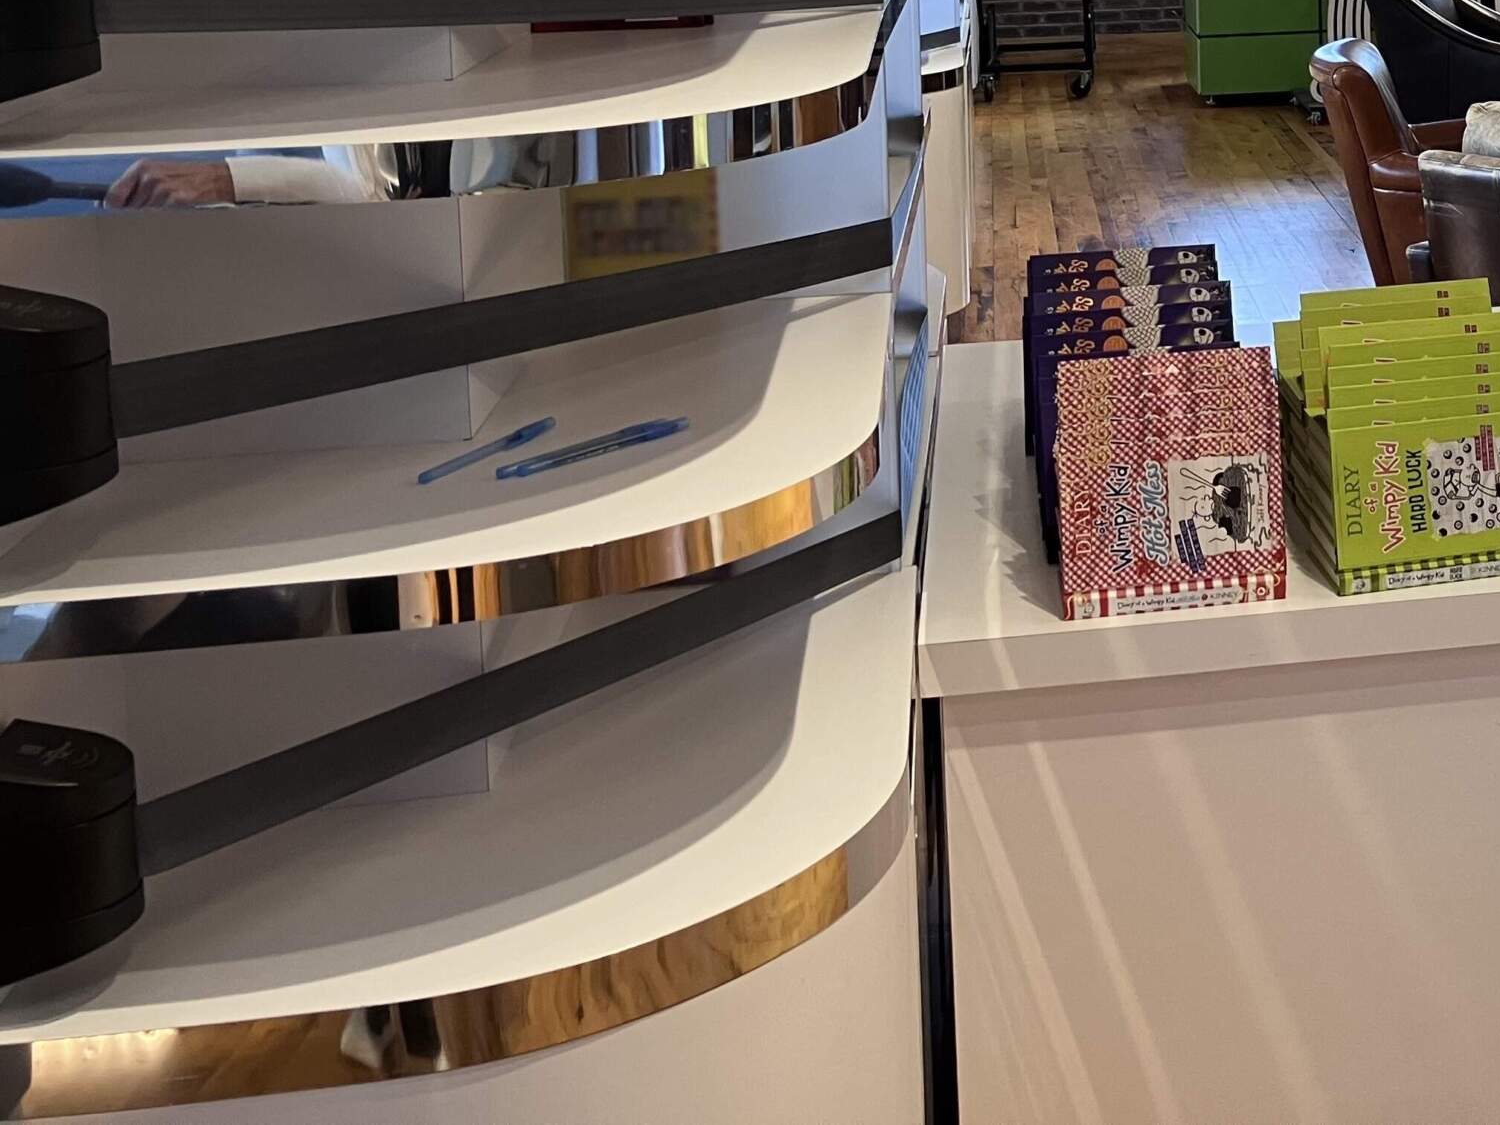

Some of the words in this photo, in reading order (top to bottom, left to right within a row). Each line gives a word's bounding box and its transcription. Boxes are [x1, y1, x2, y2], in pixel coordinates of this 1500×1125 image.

[1373, 441, 1400, 477] Kid
[1405, 449, 1424, 490] LUCK
[1104, 464, 1131, 497] Kid
[1137, 460, 1168, 517] Mess
[1368, 481, 1378, 492] a
[1100, 505, 1107, 513] a
[1343, 466, 1363, 537] DIARY
[1363, 498, 1378, 514] of
[1380, 479, 1408, 554] Wimpy
[1409, 494, 1428, 534] HARD
[1074, 490, 1091, 555] DIARY
[1094, 519, 1107, 534] of
[1109, 502, 1138, 573] Wimpy
[1140, 516, 1169, 566] Hot
